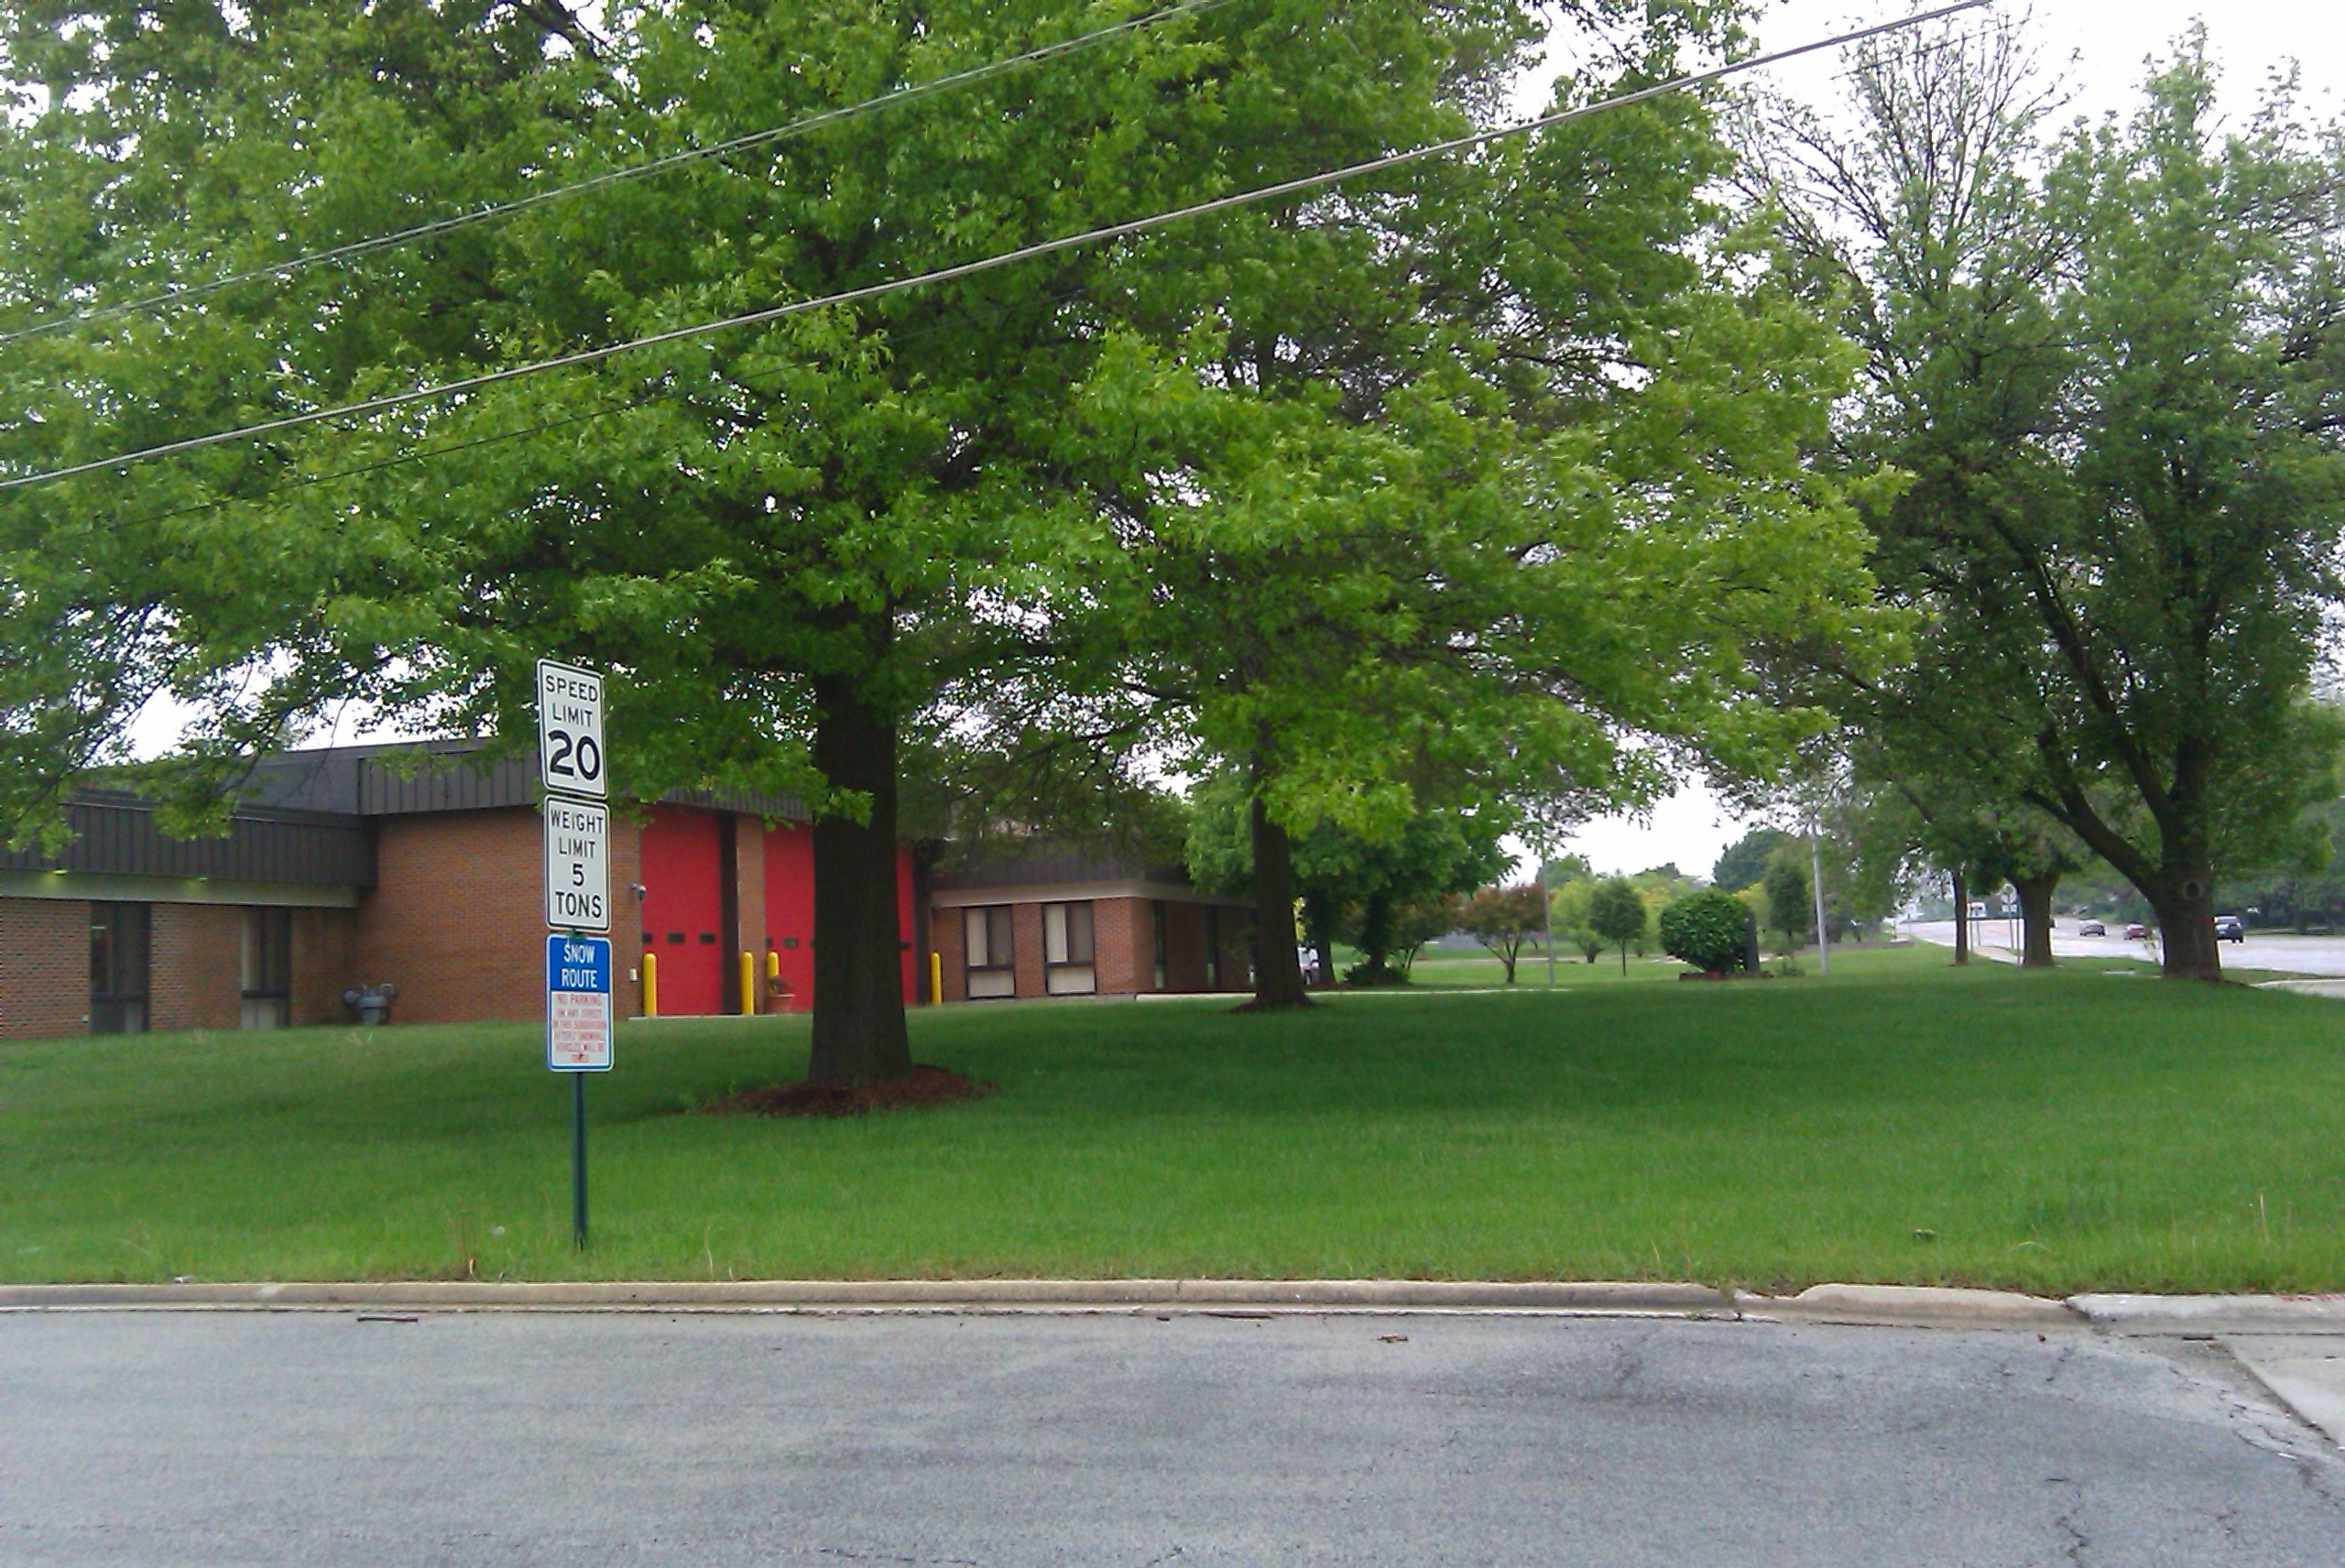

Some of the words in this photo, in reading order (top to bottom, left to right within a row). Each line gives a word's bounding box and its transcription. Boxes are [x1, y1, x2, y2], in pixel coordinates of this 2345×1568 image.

[545, 674, 598, 702] SPEED
[551, 702, 594, 727] LIMIT
[548, 729, 600, 781] 20
[551, 809, 604, 834] WEIGHT
[559, 836, 595, 859] LIMIT
[572, 862, 585, 887] 5
[555, 890, 603, 919] TONS
[563, 944, 595, 964] SNOW
[561, 968, 598, 988] ROUTE
